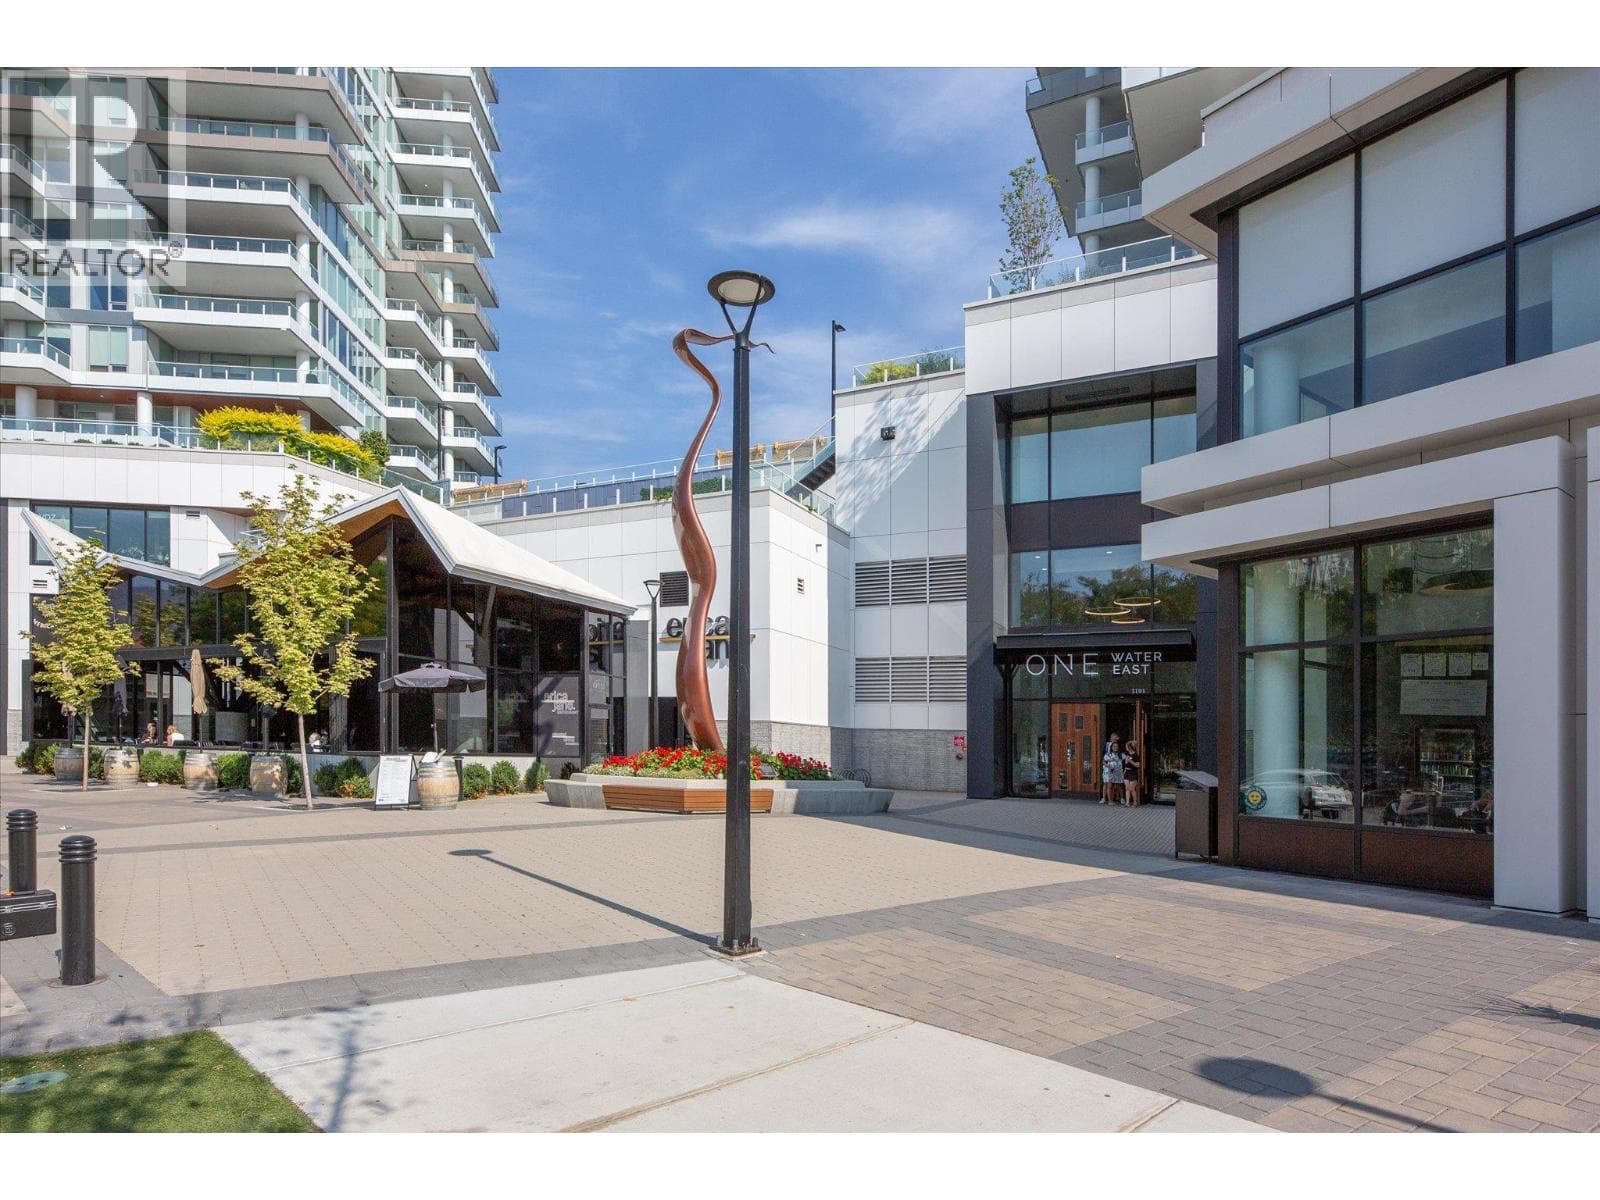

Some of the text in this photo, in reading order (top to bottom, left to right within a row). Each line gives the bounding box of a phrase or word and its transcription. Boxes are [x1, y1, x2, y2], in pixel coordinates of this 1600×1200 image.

[1026, 652, 1162, 675] ONE WATER
[1112, 664, 1150, 675] EAST
